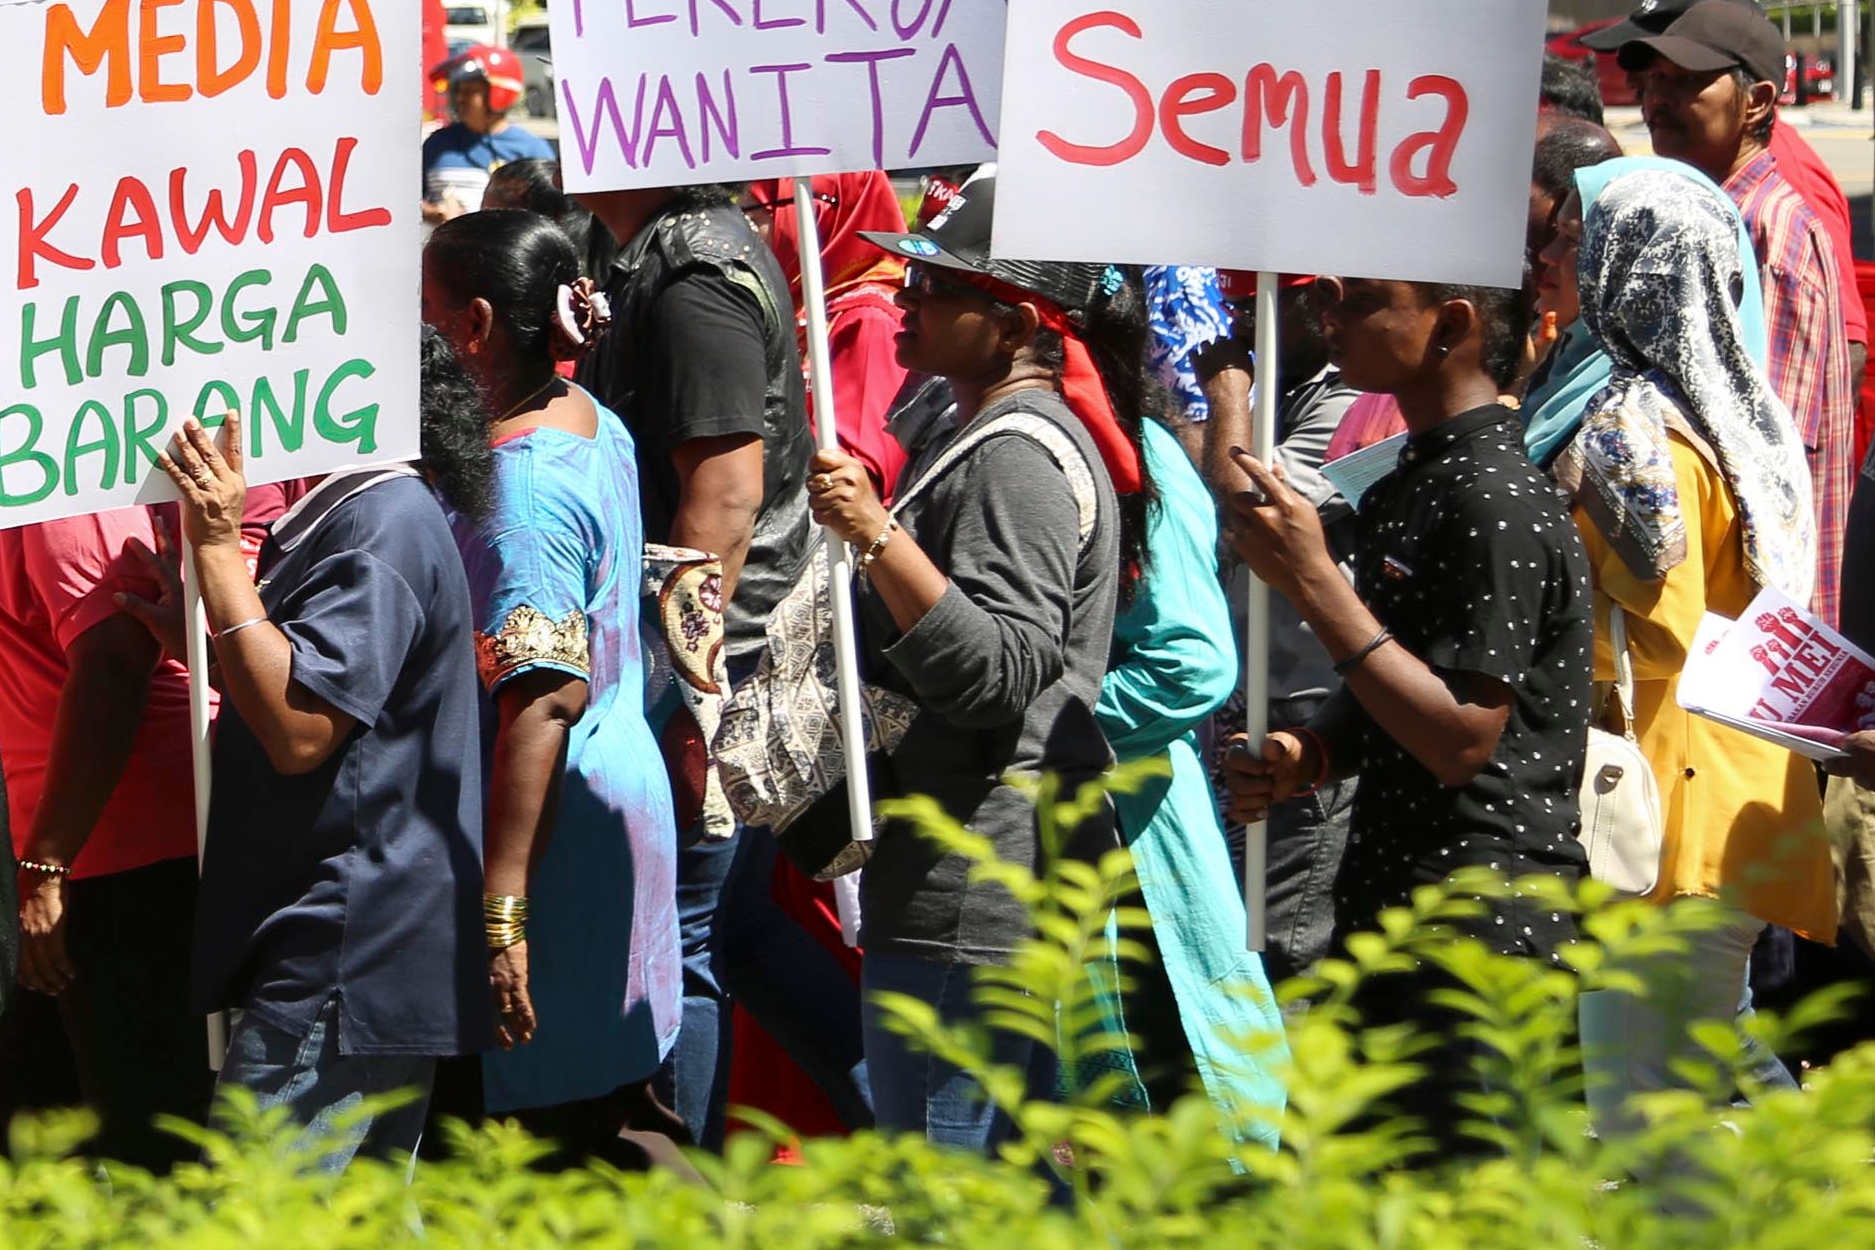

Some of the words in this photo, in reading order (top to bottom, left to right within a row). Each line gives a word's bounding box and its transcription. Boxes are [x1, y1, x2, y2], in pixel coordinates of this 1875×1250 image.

[561, 42, 998, 175] WANITA
[1036, 10, 1469, 199] Semua
[15, 136, 392, 289] KAWAL
[21, 264, 348, 389] HARGA
[1770, 631, 1843, 704] MEI
